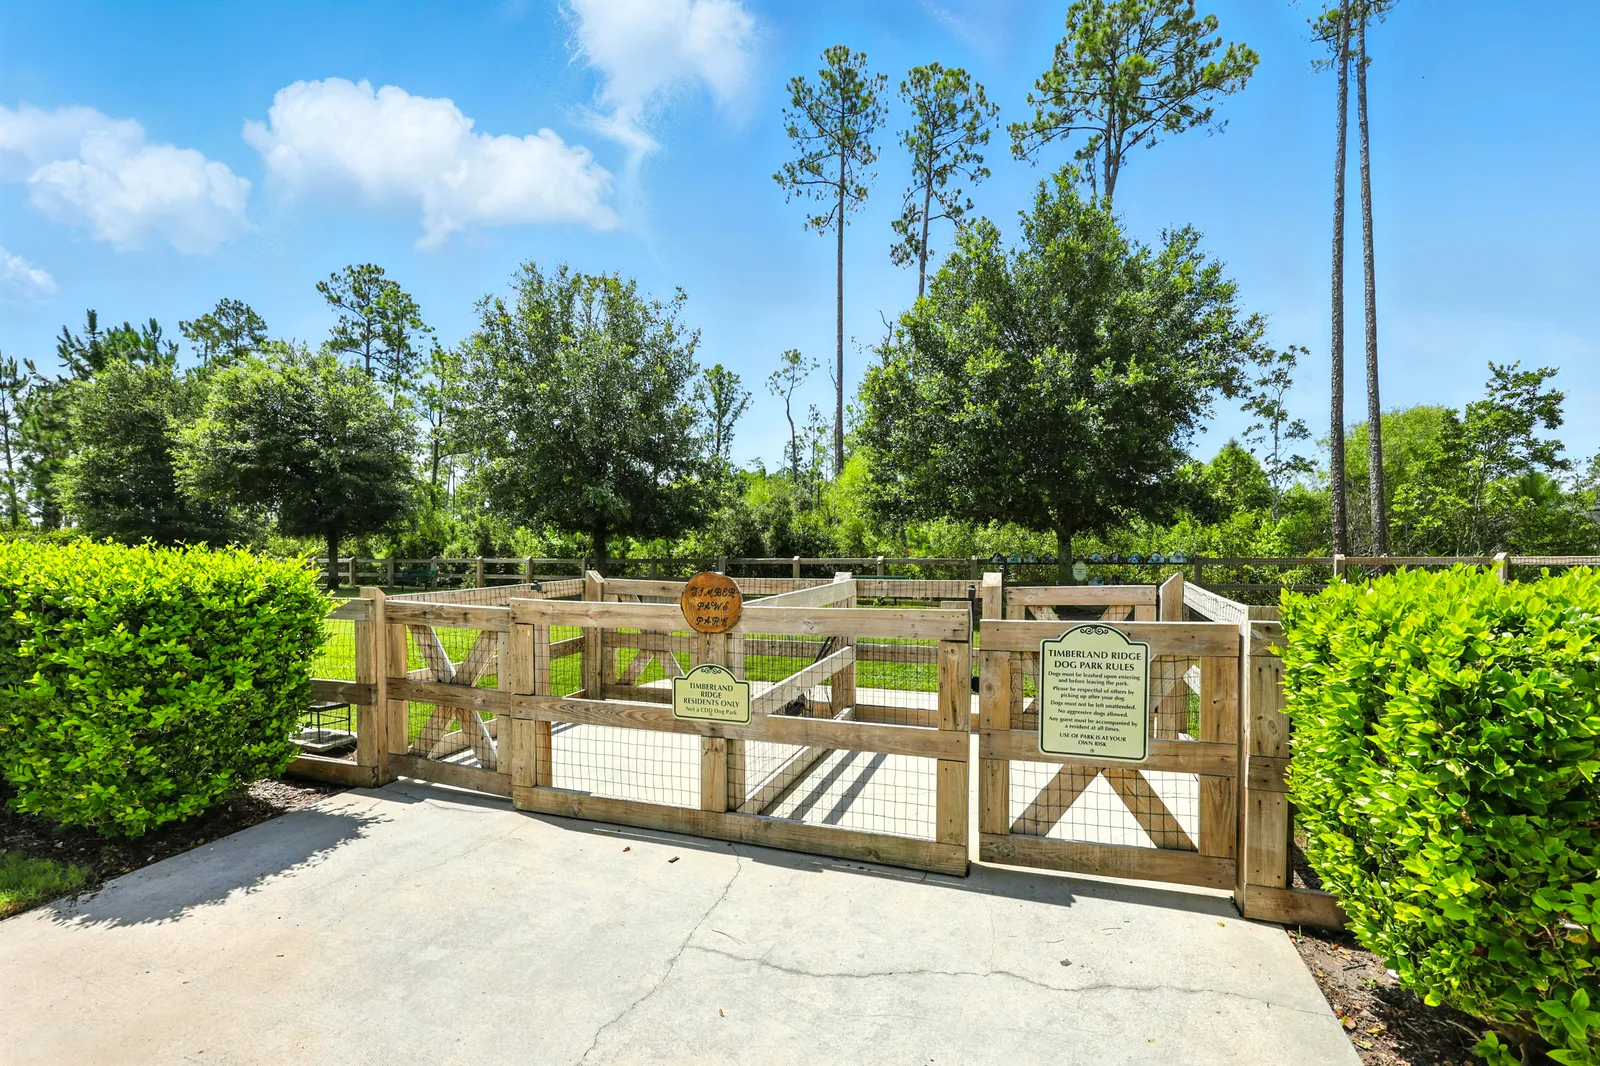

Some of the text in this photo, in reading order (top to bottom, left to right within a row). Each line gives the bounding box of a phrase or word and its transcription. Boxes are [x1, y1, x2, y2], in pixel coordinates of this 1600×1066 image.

[691, 587, 736, 598] TIMBER
[697, 601, 729, 610] PAWS
[696, 616, 729, 627] PARK
[1048, 650, 1108, 659] TIMBERLAND
[690, 683, 733, 691] TIMBERLAND
